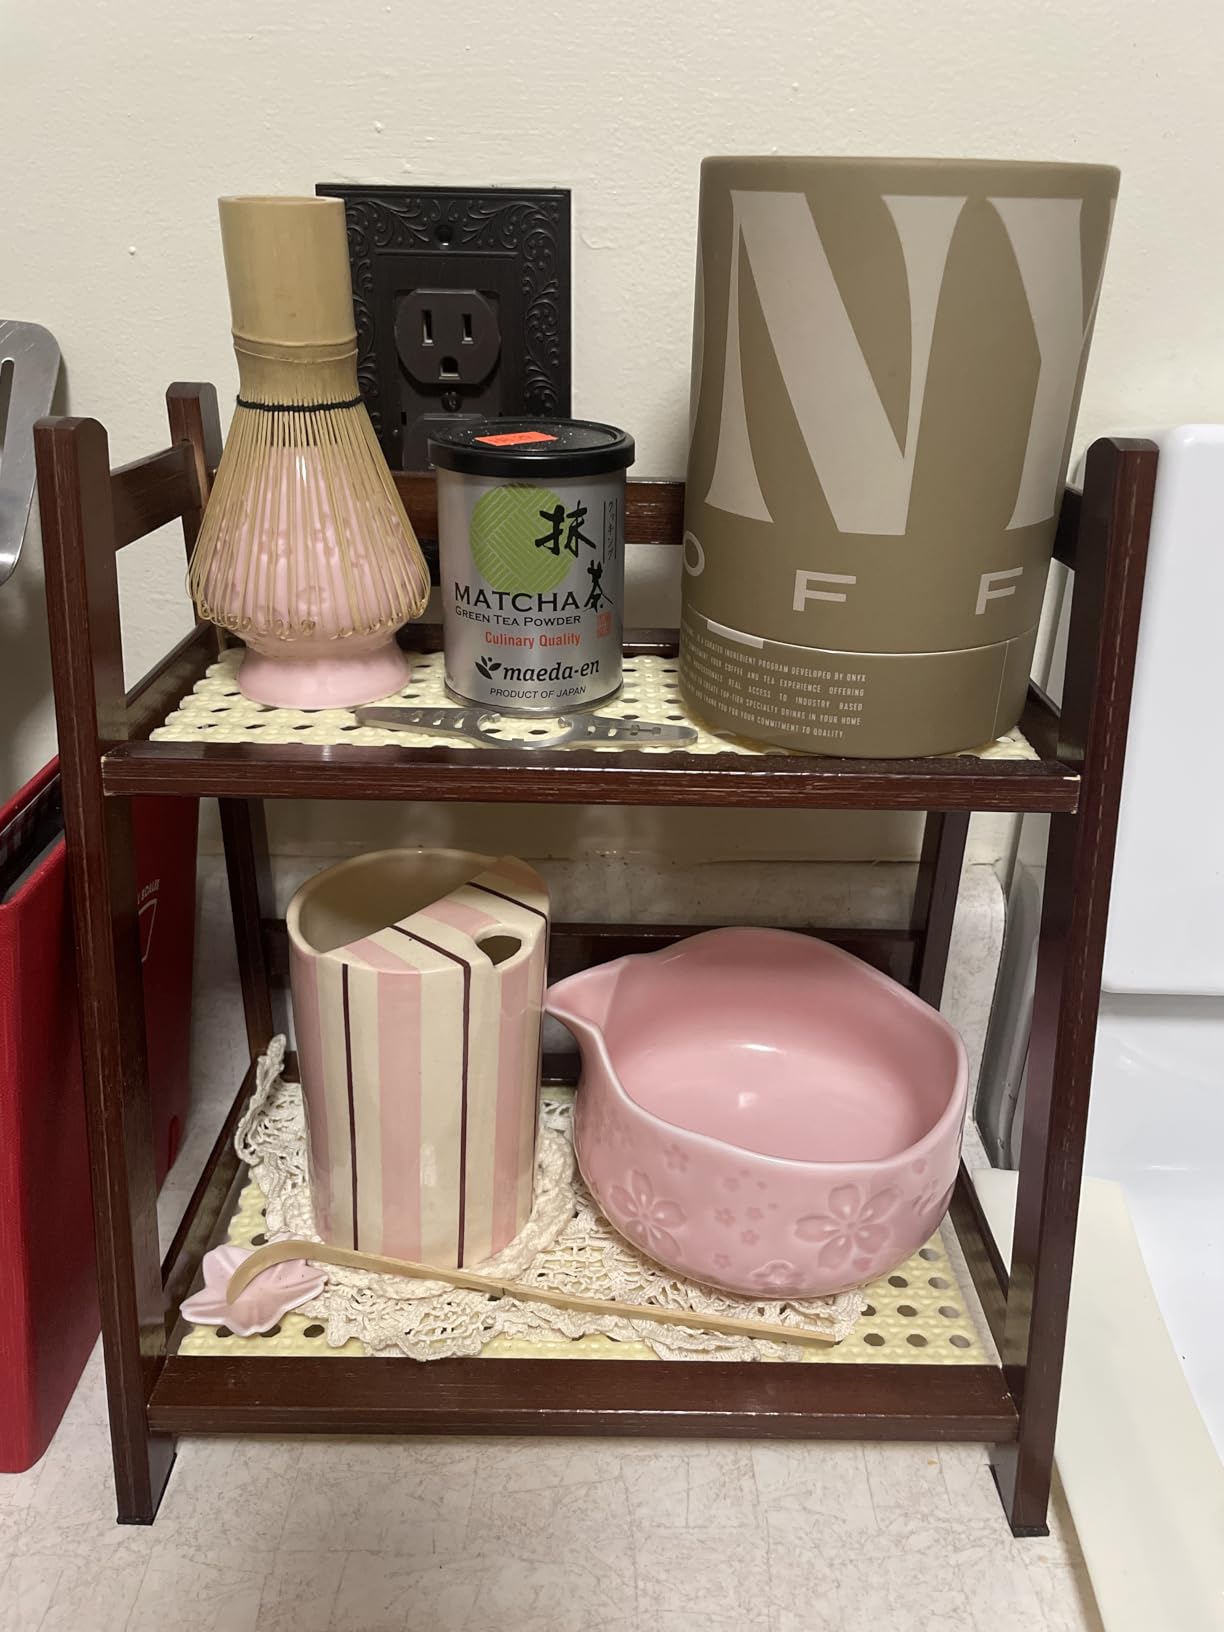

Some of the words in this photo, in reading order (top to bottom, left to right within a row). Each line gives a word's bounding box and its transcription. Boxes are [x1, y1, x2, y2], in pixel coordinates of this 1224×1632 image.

[535, 500, 614, 614] 抹茶
[454, 582, 580, 612] MATCHA
[455, 606, 490, 623] GREEN
[494, 615, 520, 627] TEA
[524, 615, 581, 627] POWDER
[485, 631, 534, 650] Culinary
[539, 633, 581, 647] Quality
[503, 659, 600, 682] maeda-en
[724, 648, 756, 664] INGREDIENT
[758, 659, 789, 673] PROGRAM
[791, 666, 831, 680] DEVELOPED
[834, 672, 843, 681] BY
[846, 673, 866, 682] ONYX
[724, 663, 743, 676] COFFEE
[747, 671, 759, 681] AND
[763, 675, 775, 685] TEA
[828, 686, 865, 697] OFFERING
[489, 687, 538, 699] PRODUCT
[541, 690, 554, 699] OF
[556, 685, 586, 698] JAPAN
[728, 678, 741, 689] REAL
[748, 685, 771, 698] ACCESS
[779, 693, 788, 702] TO
[795, 696, 830, 708] INDUSTRY
[839, 702, 863, 711] BASED
[718, 702, 728, 713] YOU
[729, 706, 738, 717] FOR
[740, 711, 755, 722] YOUR
[757, 716, 799, 732] COMMITMENT
[802, 726, 811, 734] TO
[813, 727, 843, 738] QUALITY
[746, 698, 778, 714] SPECIALTY
[781, 707, 806, 720] DRINKS
[808, 712, 816, 721] IN
[820, 714, 838, 723] YOUR
